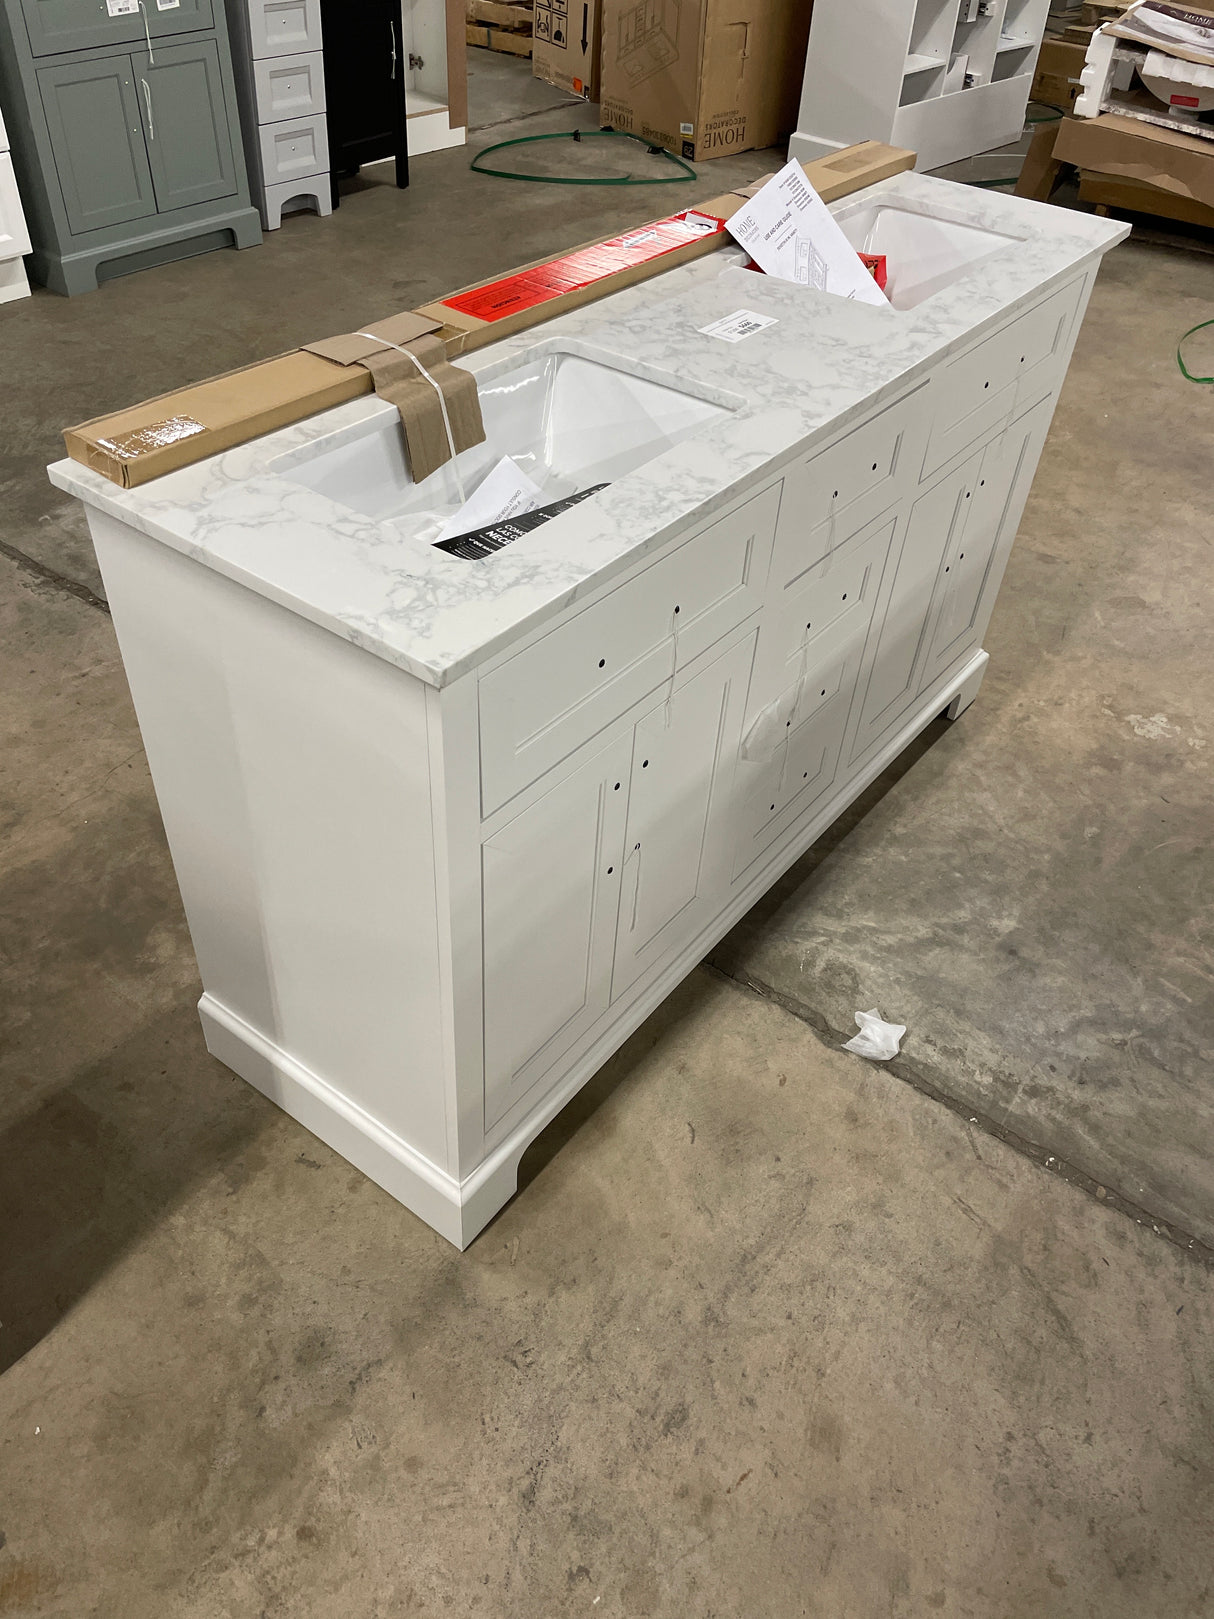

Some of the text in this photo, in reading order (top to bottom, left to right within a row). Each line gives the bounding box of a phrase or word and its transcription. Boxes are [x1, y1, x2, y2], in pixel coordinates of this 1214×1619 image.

[604, 107, 633, 129] HOME
[705, 116, 747, 132] DECORATORS
[704, 127, 745, 148] HOME
[735, 215, 756, 237] HOME
